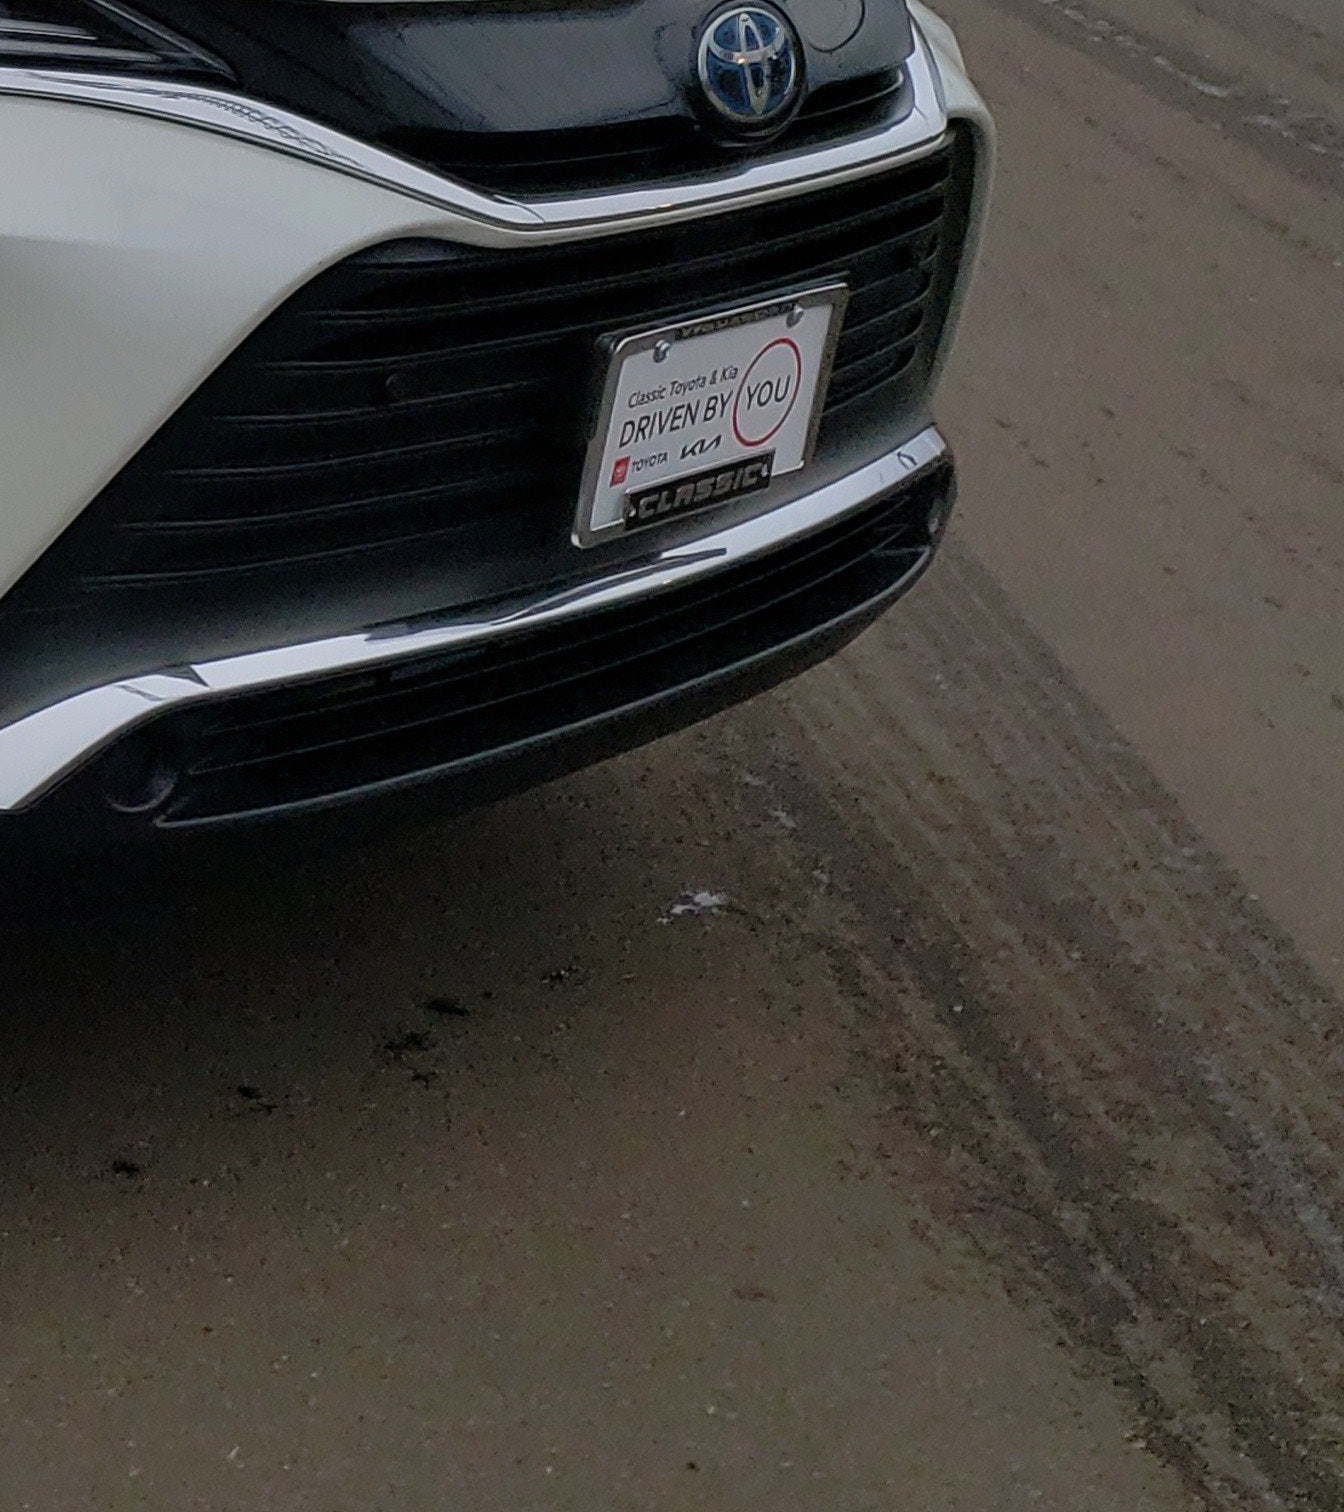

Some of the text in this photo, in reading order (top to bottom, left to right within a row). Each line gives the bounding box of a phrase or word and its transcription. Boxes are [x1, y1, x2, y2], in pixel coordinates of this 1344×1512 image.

[619, 374, 791, 448] DRIVEN BY YOU
[628, 364, 739, 409] Classic Toyota & Kia
[632, 451, 668, 473] TOYOTA
[638, 461, 764, 519] CLASSIC
